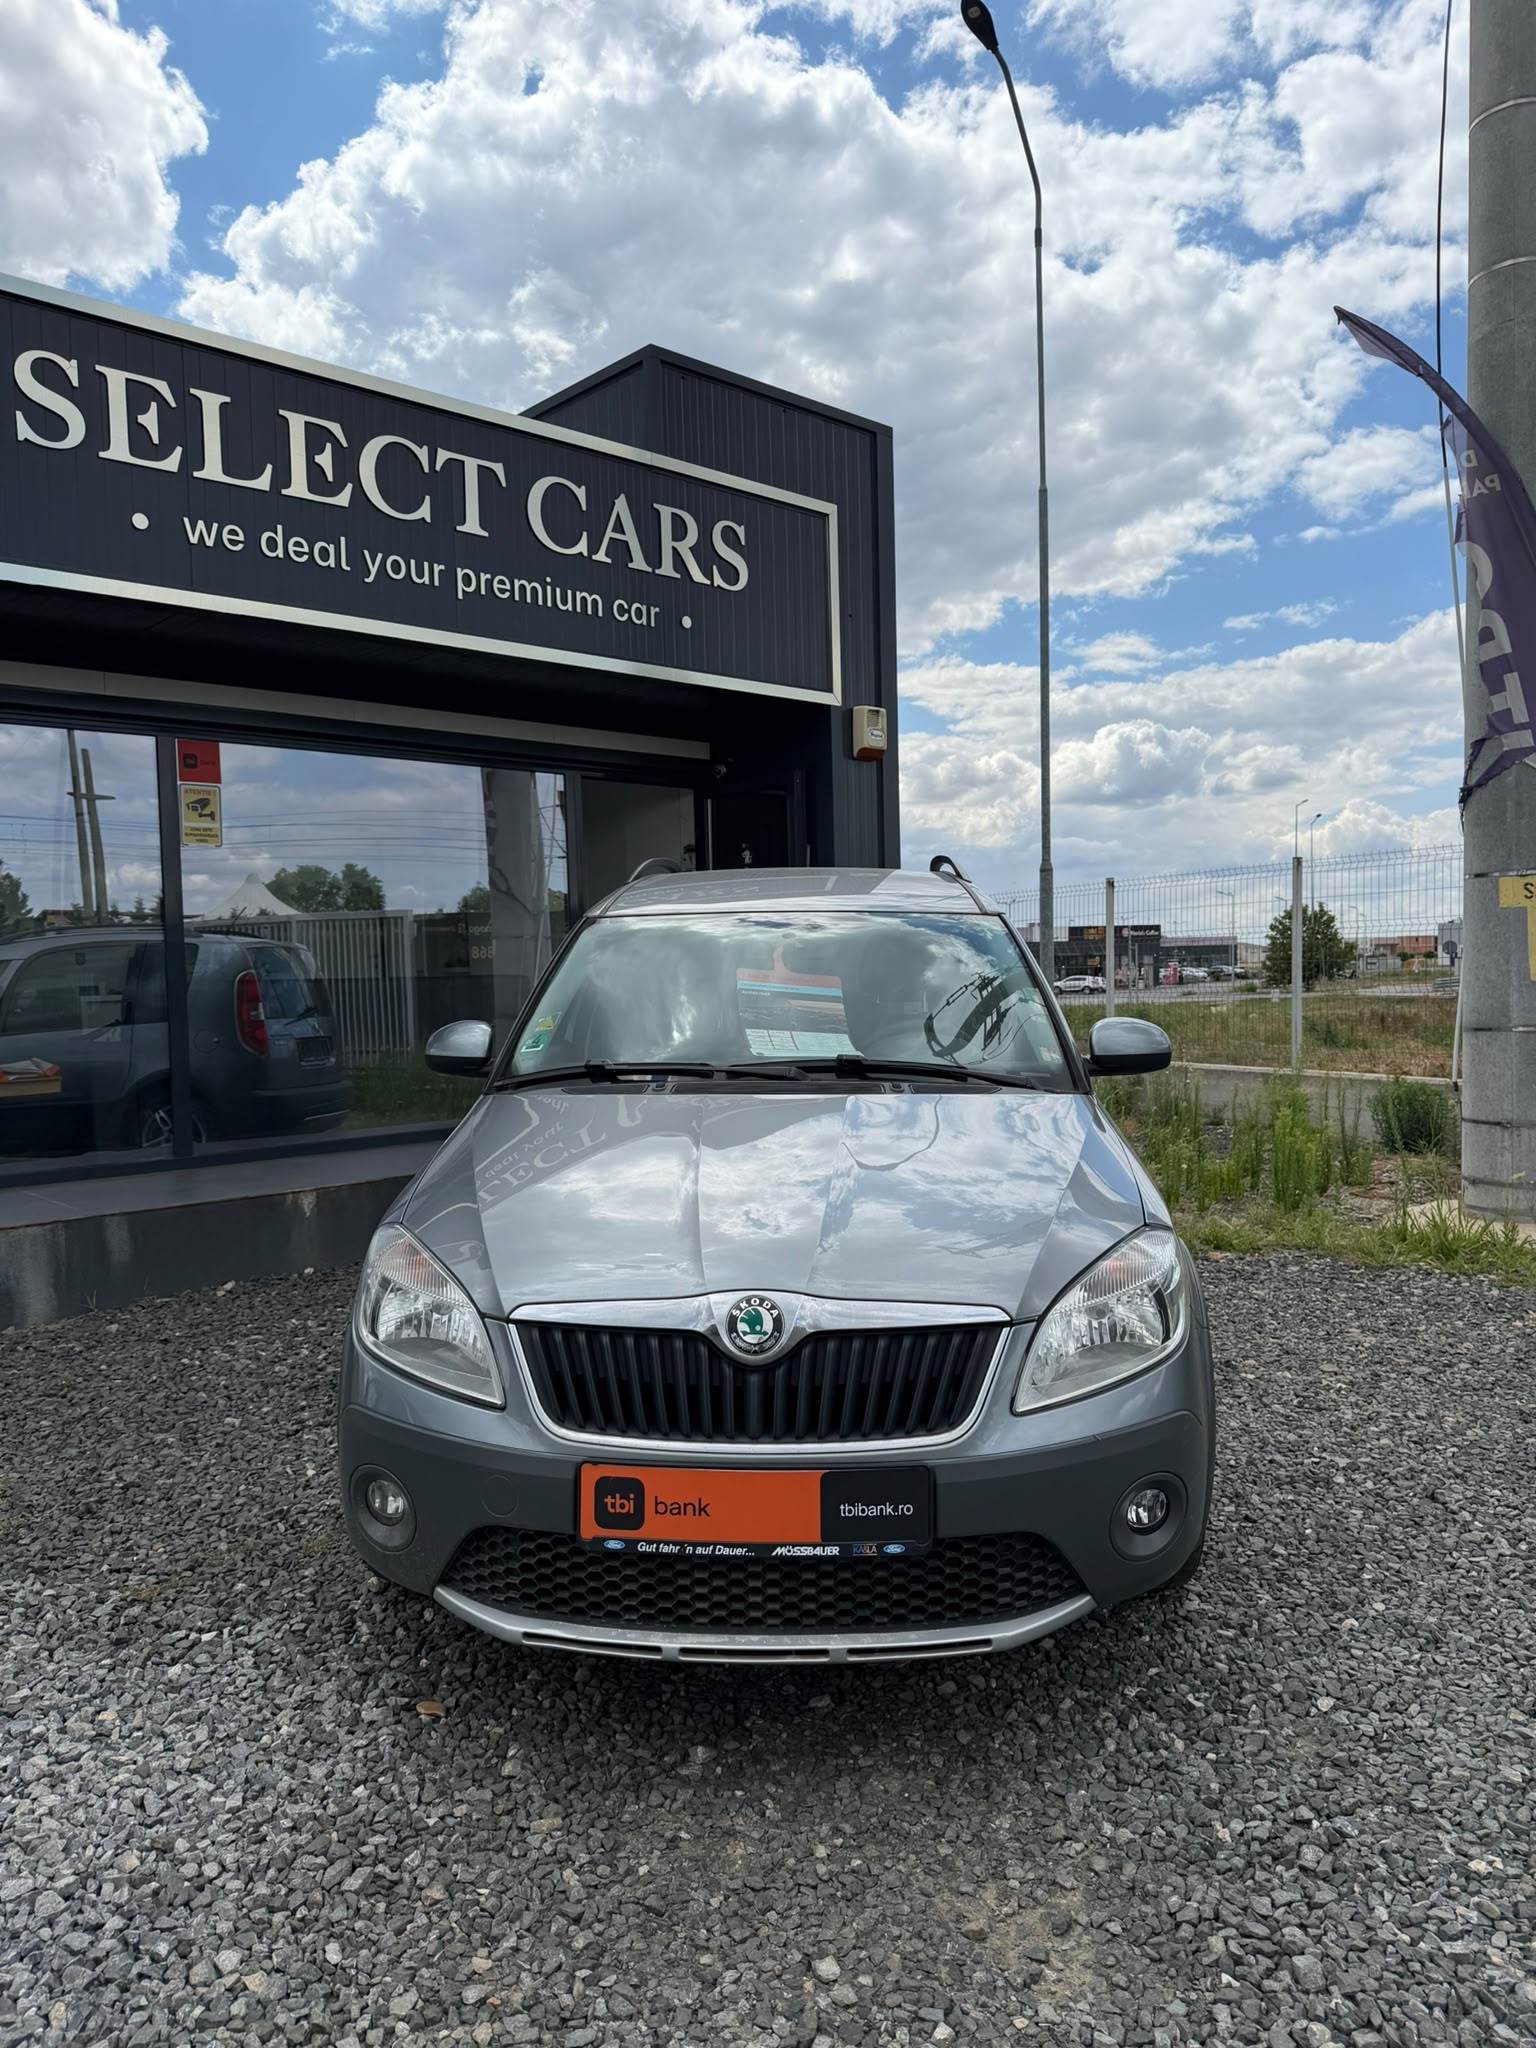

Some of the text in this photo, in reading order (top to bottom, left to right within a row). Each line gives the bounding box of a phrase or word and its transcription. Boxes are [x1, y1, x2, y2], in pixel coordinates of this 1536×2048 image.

[13, 349, 749, 591] SELECT CARS
[182, 516, 660, 627] we deal your premium car
[604, 1493, 711, 1517] tbi bank
[839, 1501, 914, 1517] tbibank.ro
[637, 1541, 657, 1553] Gut
[658, 1541, 680, 1554] fahr
[695, 1544, 714, 1555] auf
[715, 1544, 756, 1556] Dauer...
[771, 1545, 840, 1556] MÖSSBAUER
